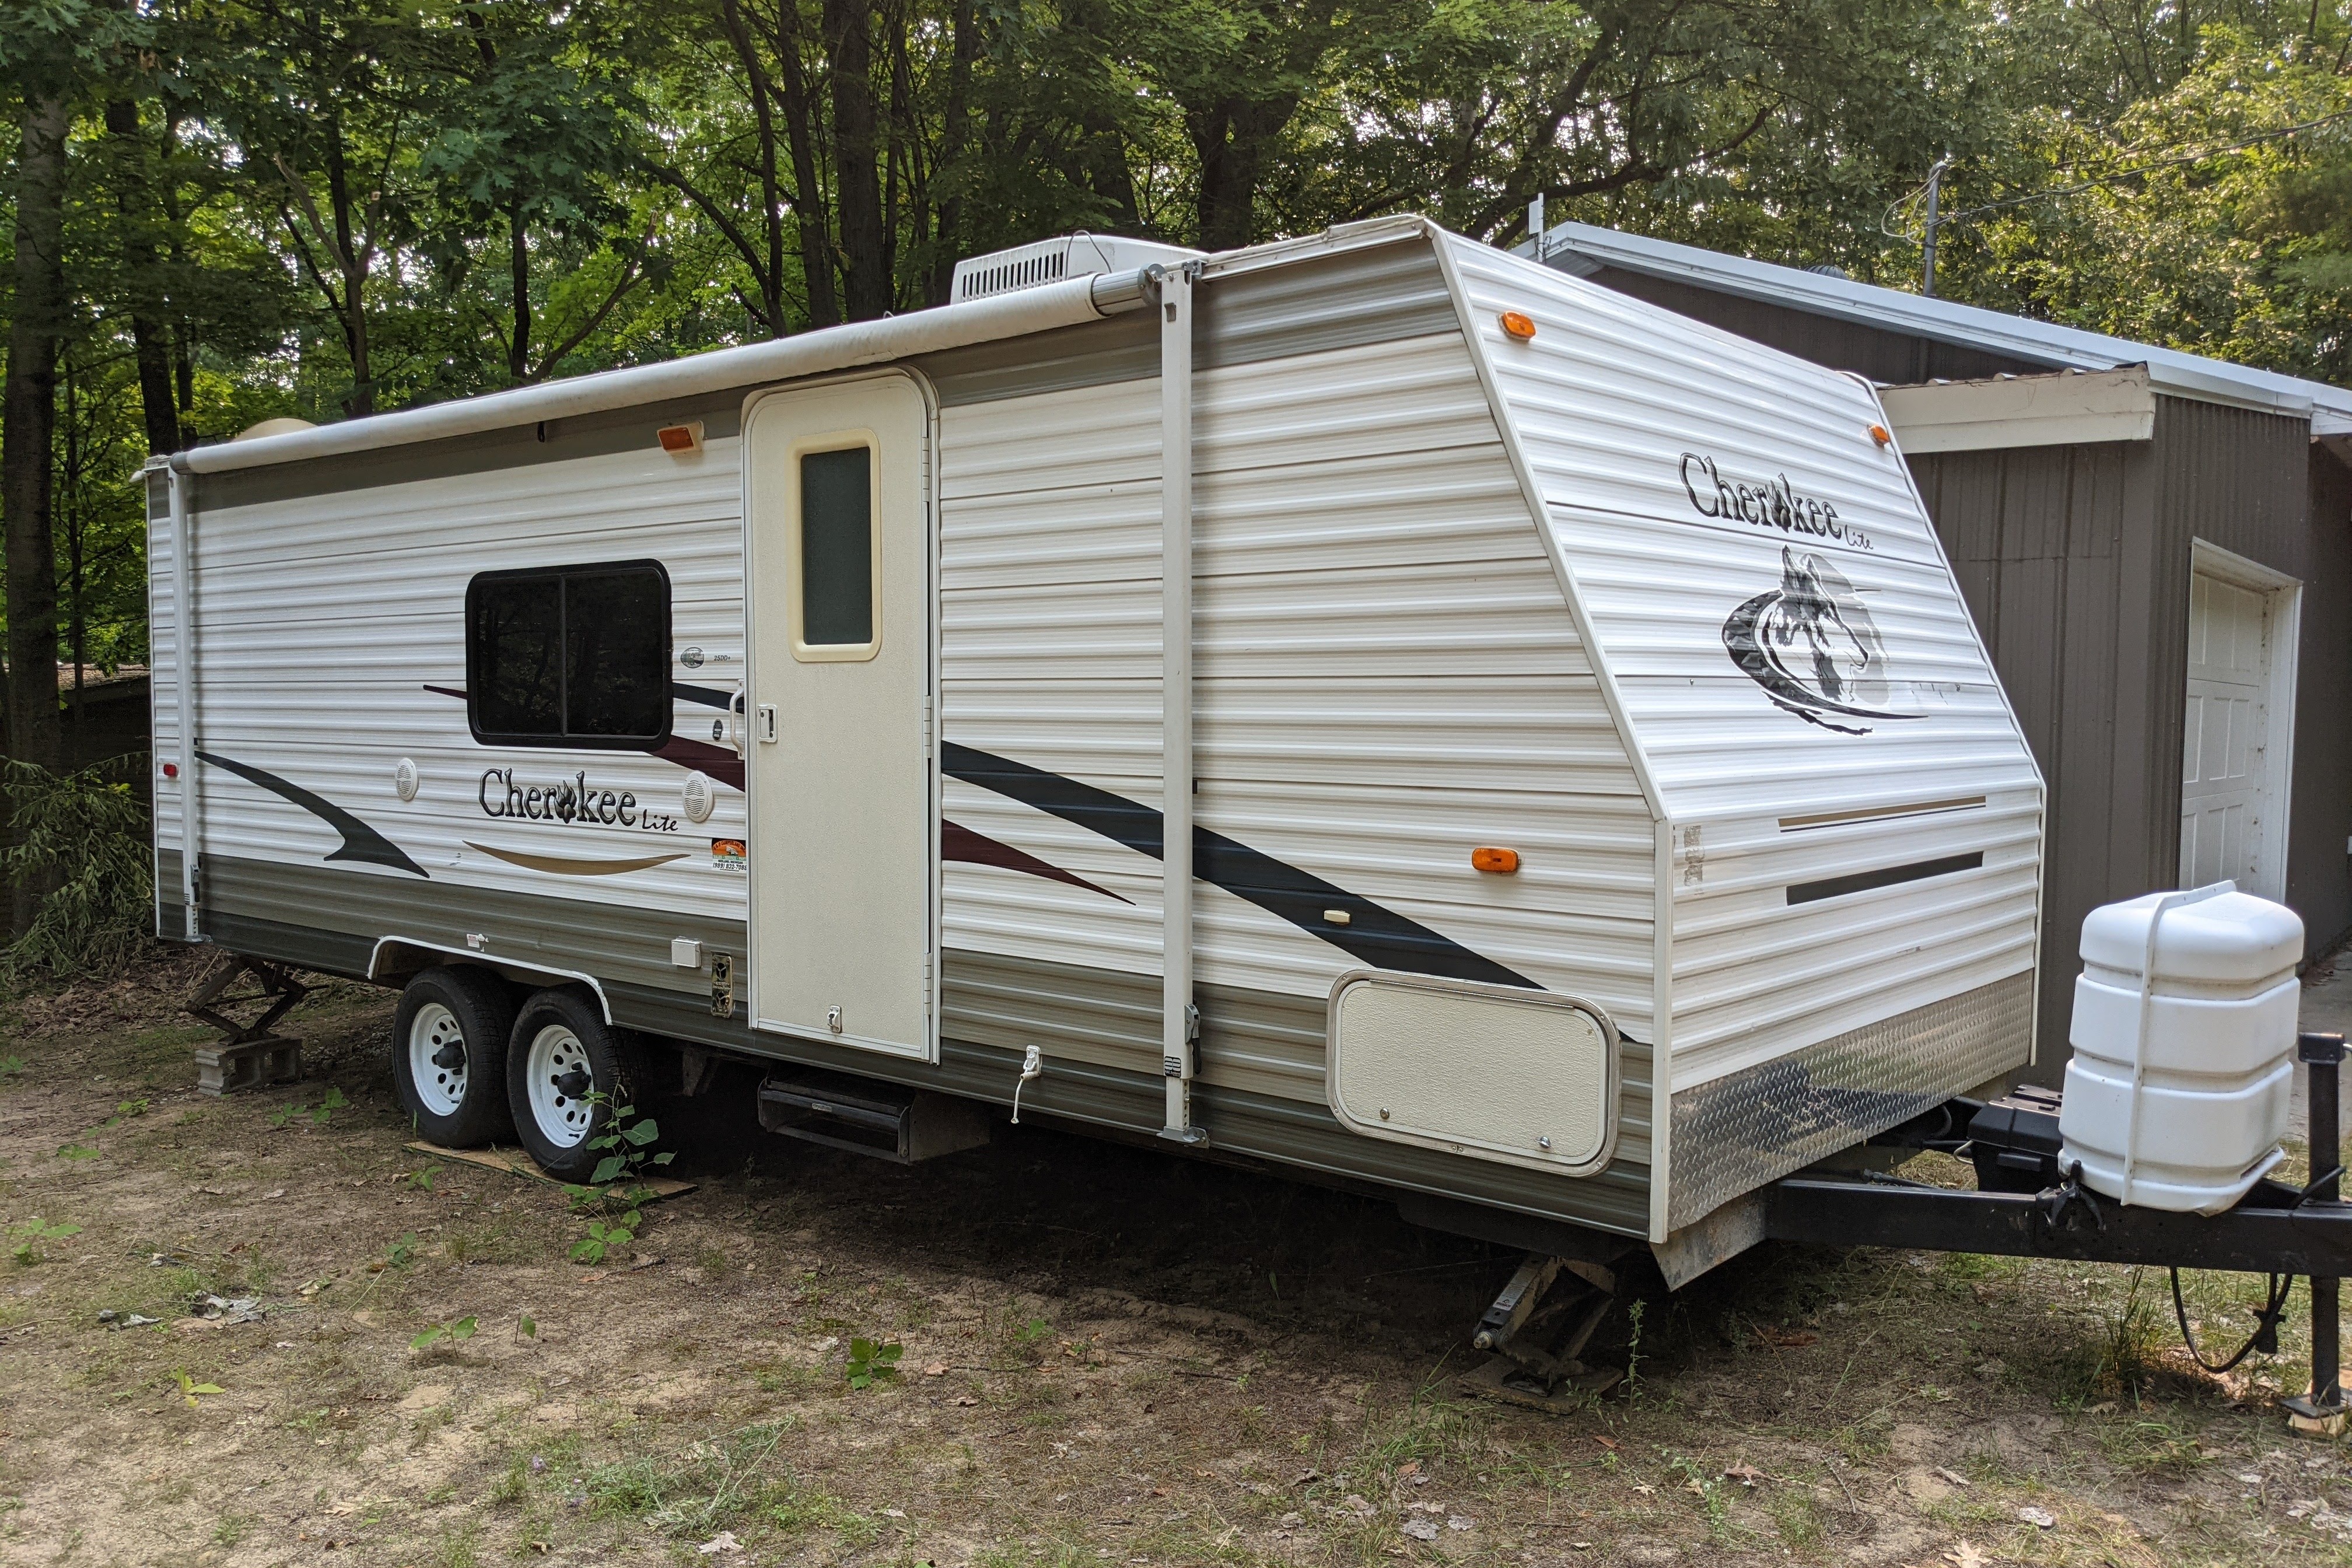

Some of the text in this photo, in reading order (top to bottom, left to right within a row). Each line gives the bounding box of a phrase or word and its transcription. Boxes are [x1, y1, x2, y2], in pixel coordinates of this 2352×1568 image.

[1678, 452, 1842, 540] Cherokee
[478, 767, 678, 832] Cherokee Lite
